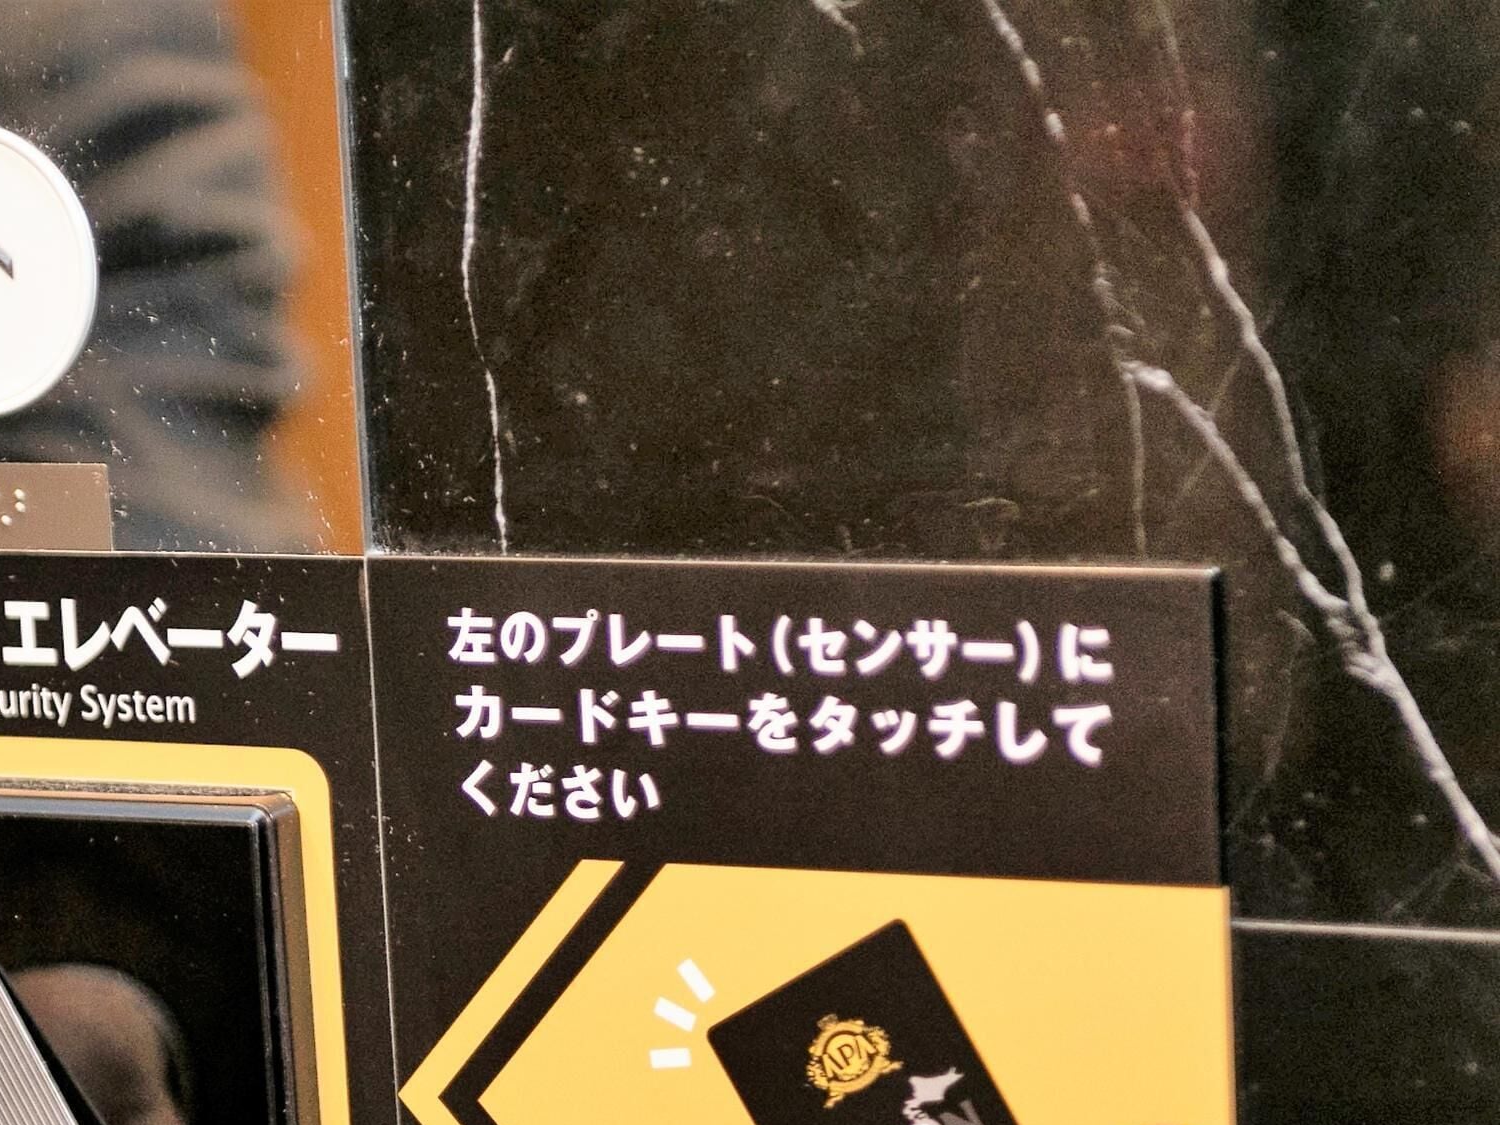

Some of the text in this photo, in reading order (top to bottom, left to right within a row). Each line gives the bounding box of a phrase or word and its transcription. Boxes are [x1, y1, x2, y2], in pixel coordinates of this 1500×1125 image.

[80, 685, 196, 728] System
[455, 684, 1113, 766] カードキーをタッチして
[461, 759, 660, 820] ください
